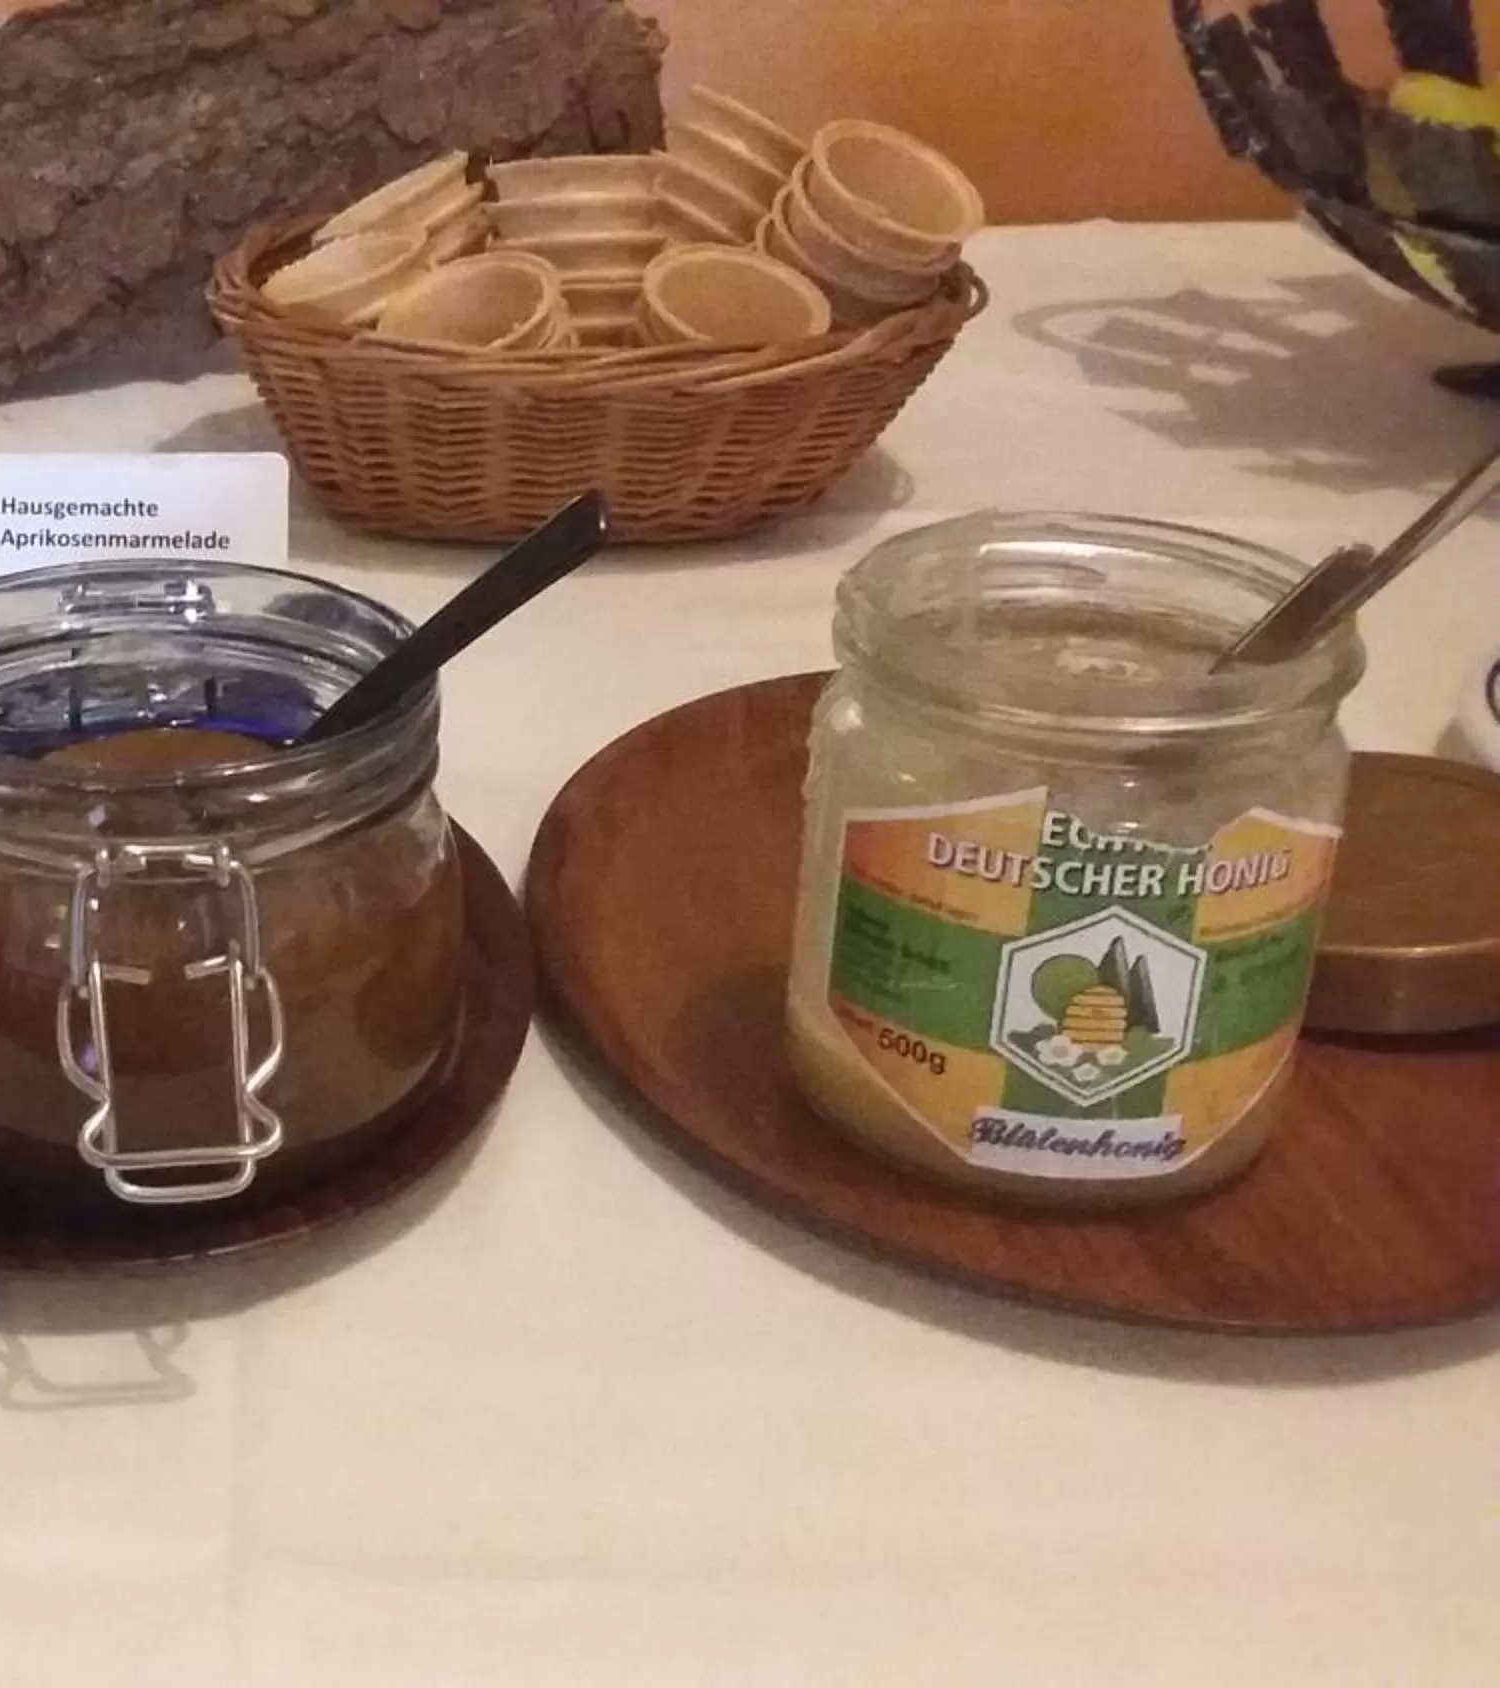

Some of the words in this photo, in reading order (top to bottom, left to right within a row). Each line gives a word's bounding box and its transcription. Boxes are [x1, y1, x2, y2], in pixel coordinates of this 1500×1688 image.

[0, 497, 159, 520] Hausgemachte
[0, 528, 231, 551] Aprikosenmarmelade
[927, 830, 1165, 898] DEUTSCHER
[1176, 849, 1293, 896] HONIG
[877, 1027, 947, 1075] 500g
